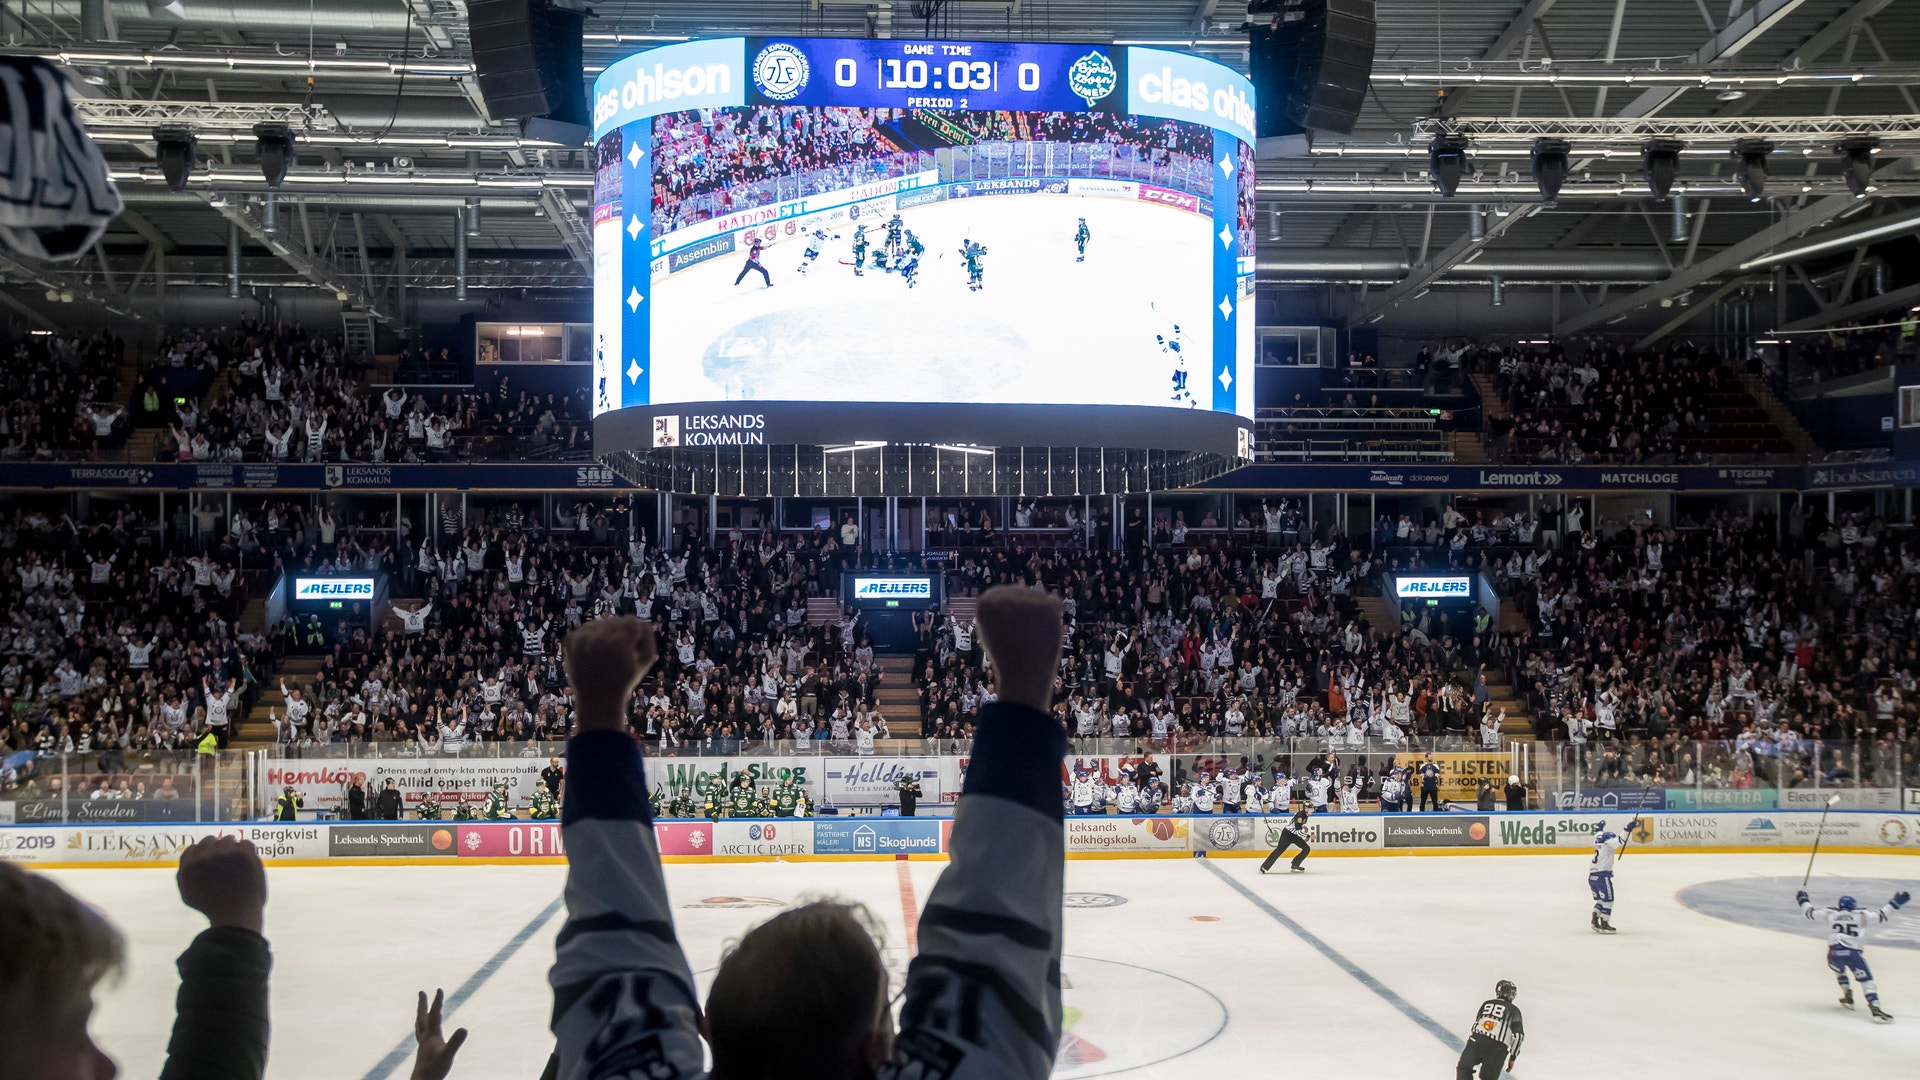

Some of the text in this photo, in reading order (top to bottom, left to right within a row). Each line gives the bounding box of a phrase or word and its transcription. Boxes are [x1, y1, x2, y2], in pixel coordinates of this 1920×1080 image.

[904, 44, 972, 56] GAME TIME
[835, 58, 857, 87] 0
[886, 59, 991, 91] 10:03
[1018, 62, 1040, 92] 0
[622, 63, 730, 110] ohlson
[1138, 66, 1209, 112] clas
[908, 97, 968, 109] PERIOD 2
[939, 121, 969, 146] Devils
[975, 179, 1040, 191] LEKSANDS
[1145, 189, 1193, 208] CCM
[718, 201, 808, 231] RADONETT
[675, 241, 729, 267] Assemblin
[685, 414, 765, 430] LEKSANDS
[685, 432, 763, 446] KOMMUN
[71, 469, 140, 479] TERRASSLOGE
[347, 467, 391, 475] LEKSANDS
[1479, 471, 1541, 485] Lemont
[347, 476, 391, 484] KOMMUN
[1601, 473, 1679, 484] MATCHLOGE
[310, 584, 371, 594] REJLERS
[869, 583, 928, 593] REJLERS
[1410, 582, 1468, 592] REJLERS
[433, 767, 475, 776] omtykta
[747, 762, 807, 785] Skog
[438, 777, 476, 790] öppet
[501, 777, 518, 788] 23
[1685, 790, 1763, 805] LKEXTRA
[77, 801, 138, 818] Sweden
[1069, 823, 1117, 832] Leksands
[1659, 817, 1717, 828] LEKSANDS
[252, 829, 318, 843] Bergkvist
[1388, 826, 1463, 837] Leksands Sparbank
[1500, 819, 1557, 845] Weda
[1659, 830, 1717, 840] KOMMUN
[16, 836, 56, 850] 2019
[334, 833, 424, 847] Leksands Sparbank
[817, 838, 840, 846] MÅLERI
[857, 837, 872, 848] NS
[879, 836, 937, 850] Skoglunds
[1069, 834, 1137, 847] folkhögskola
[257, 843, 295, 858] nsjön
[721, 844, 805, 854] ARCTIC PAPER
[1482, 1003, 1506, 1019] 98
